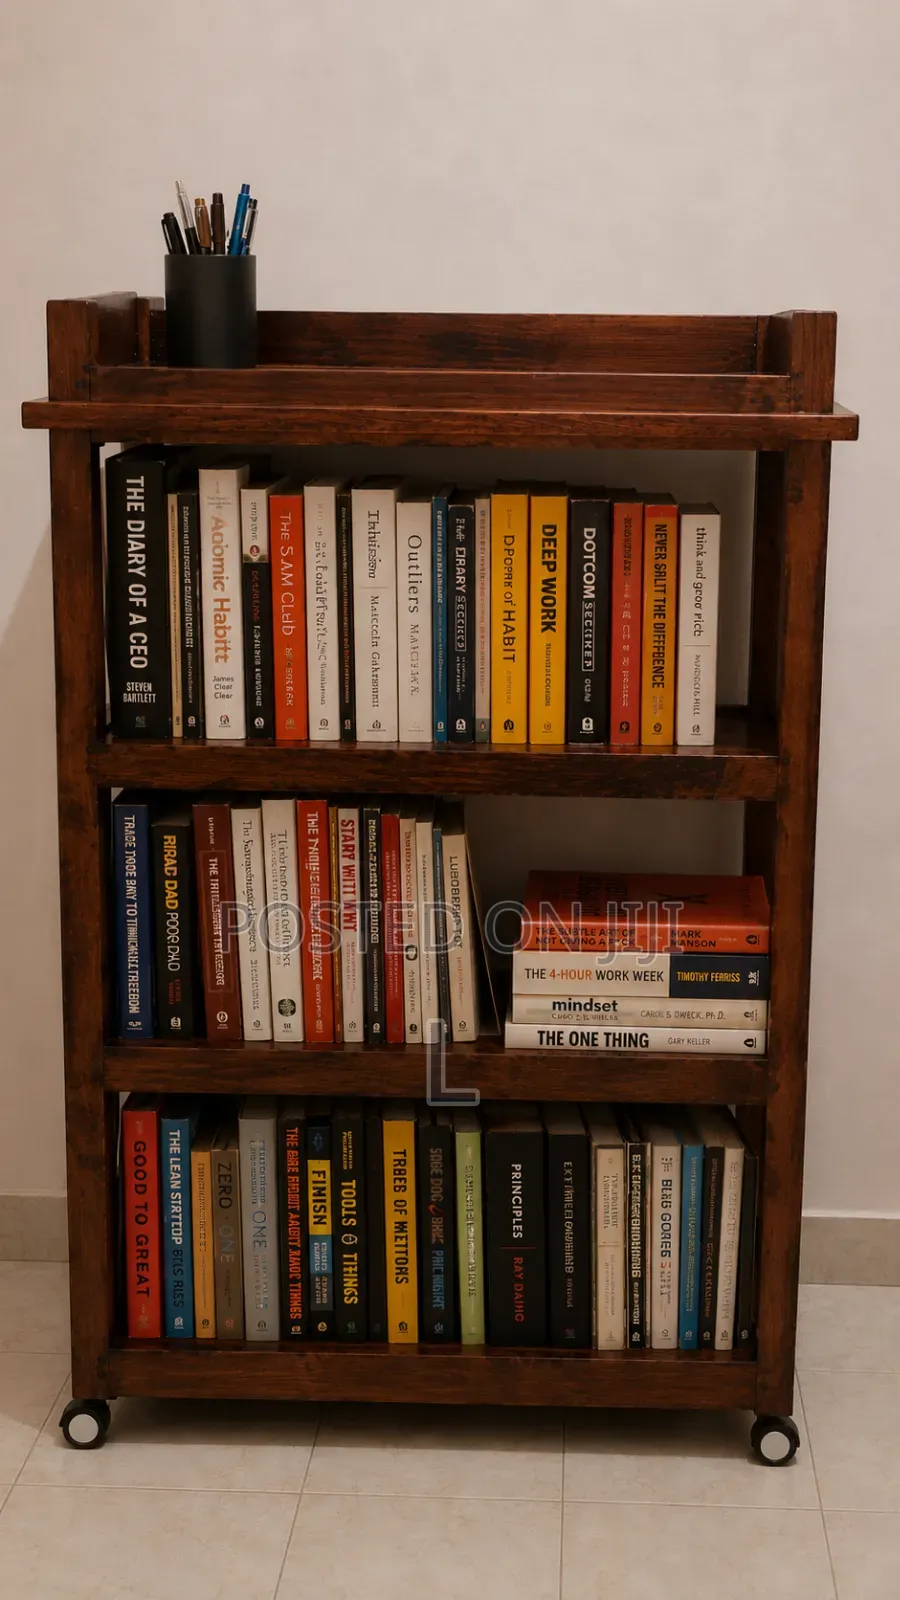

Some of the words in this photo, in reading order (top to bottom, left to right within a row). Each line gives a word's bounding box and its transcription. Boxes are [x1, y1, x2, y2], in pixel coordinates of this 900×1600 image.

[126, 475, 145, 512] THE
[127, 519, 147, 578] DIARY
[541, 524, 557, 574] DEEP
[654, 523, 668, 560] NEVER
[695, 527, 708, 558] think
[407, 534, 423, 614] Outliers
[583, 527, 597, 600] DOTCOM
[695, 560, 706, 580] and
[128, 583, 147, 607] OF
[541, 577, 557, 634] WORK
[129, 612, 147, 626] A
[653, 597, 667, 620] THE
[502, 609, 516, 663] HABIT
[129, 632, 148, 669] CEO
[122, 692, 157, 704] BARTLETT
[126, 681, 153, 692] STEVEN
[209, 857, 219, 877] THE
[165, 879, 179, 910] DAD
[536, 927, 556, 936] THE
[558, 927, 597, 937] SUBTLE
[621, 928, 636, 938] OF
[536, 936, 557, 945] NOT
[599, 937, 606, 946] A
[671, 939, 717, 949] MANSON
[672, 929, 702, 939] MARK
[525, 968, 546, 980] THE
[549, 969, 593, 980] 4-HOUR
[595, 970, 630, 982] WORK
[632, 971, 665, 983] WEEK
[676, 971, 709, 982] TIMOTHY
[552, 997, 619, 1013] mindset
[537, 1030, 564, 1046] THE
[568, 1030, 600, 1048] ONE
[603, 1031, 650, 1049] THING
[667, 1037, 686, 1046] GARY
[169, 1130, 181, 1154] THE
[287, 1127, 299, 1147] THE
[134, 1139, 147, 1195] GOOD
[170, 1157, 182, 1189] LEAN
[218, 1161, 233, 1209] ZERO
[393, 1199, 407, 1216] OF
[511, 1163, 523, 1239] PRINCIPLES
[135, 1202, 148, 1226] TO
[252, 1210, 267, 1248] ONE
[220, 1225, 235, 1263] ONE
[136, 1233, 150, 1298] GREAT
[513, 1256, 524, 1280] RAY
